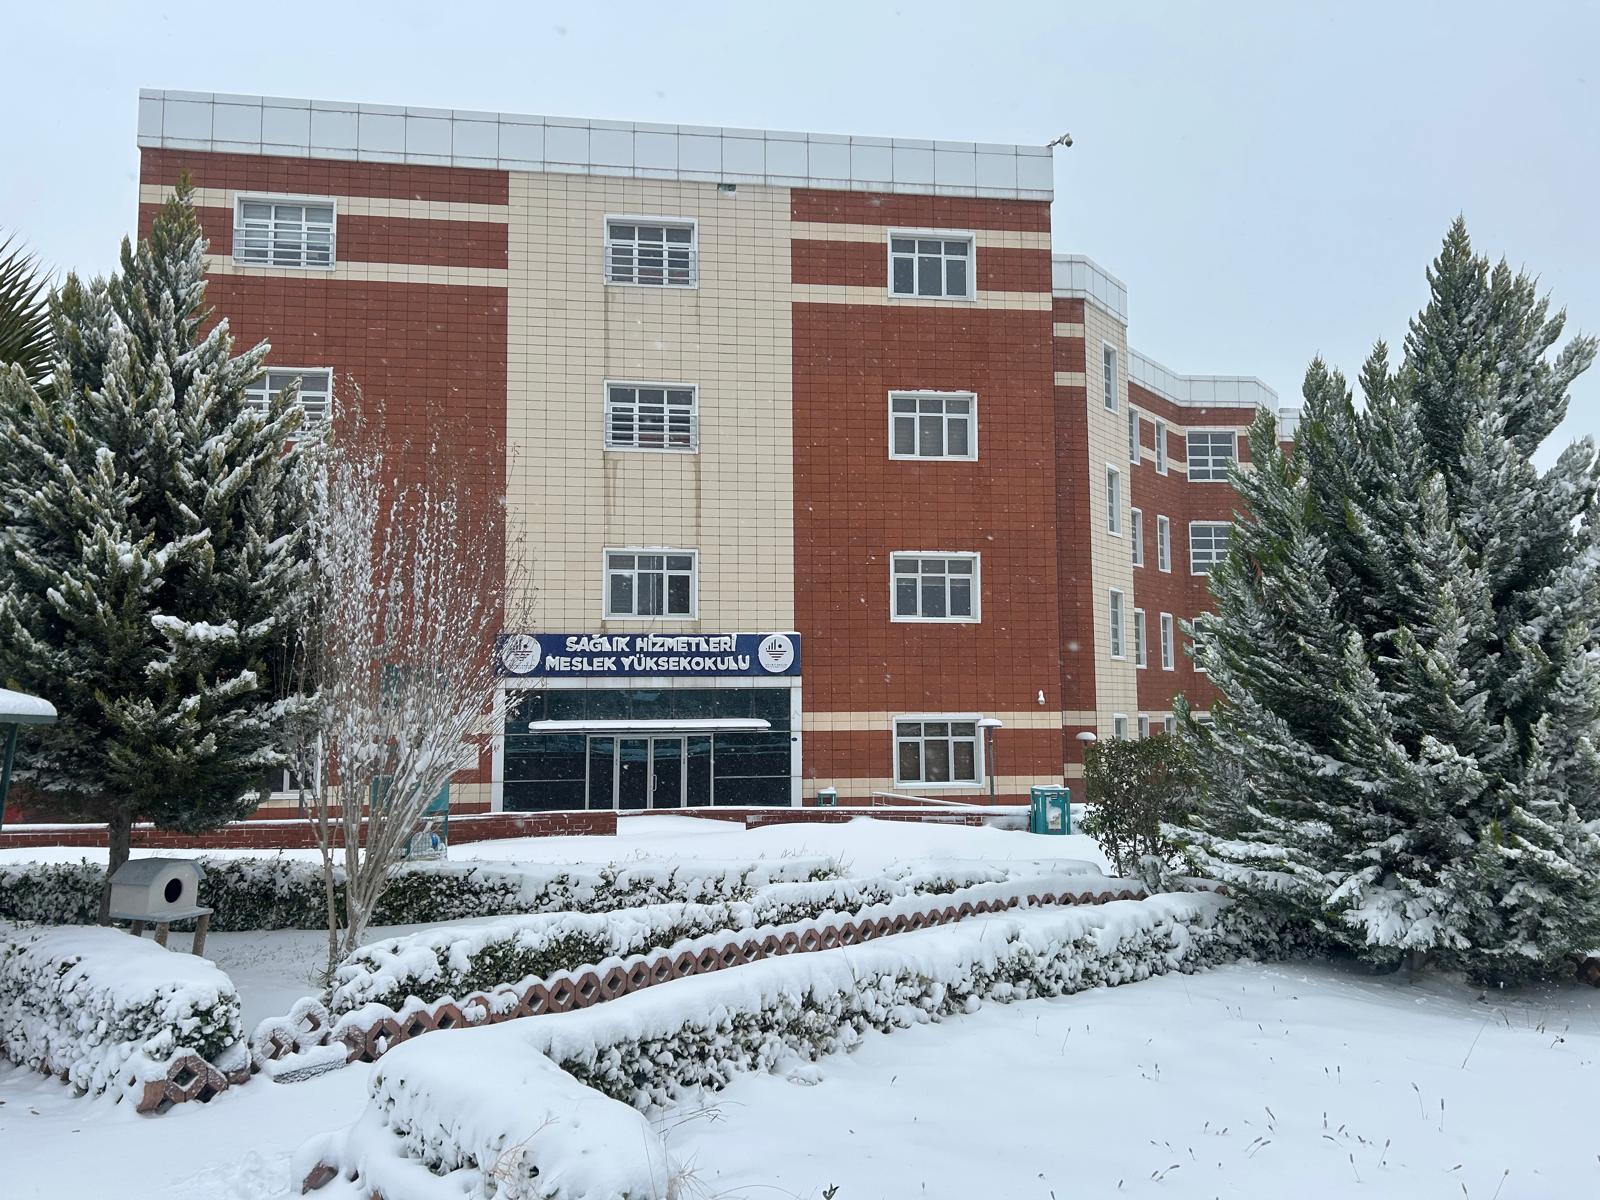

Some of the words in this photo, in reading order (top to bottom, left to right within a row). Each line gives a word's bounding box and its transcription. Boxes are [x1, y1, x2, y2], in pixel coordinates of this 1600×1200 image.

[565, 634, 631, 652] SAĞLIK
[635, 633, 738, 652] HİZMETLERİ
[545, 655, 617, 671] MESLEK
[620, 653, 750, 671] YÜKSEKOKULU
